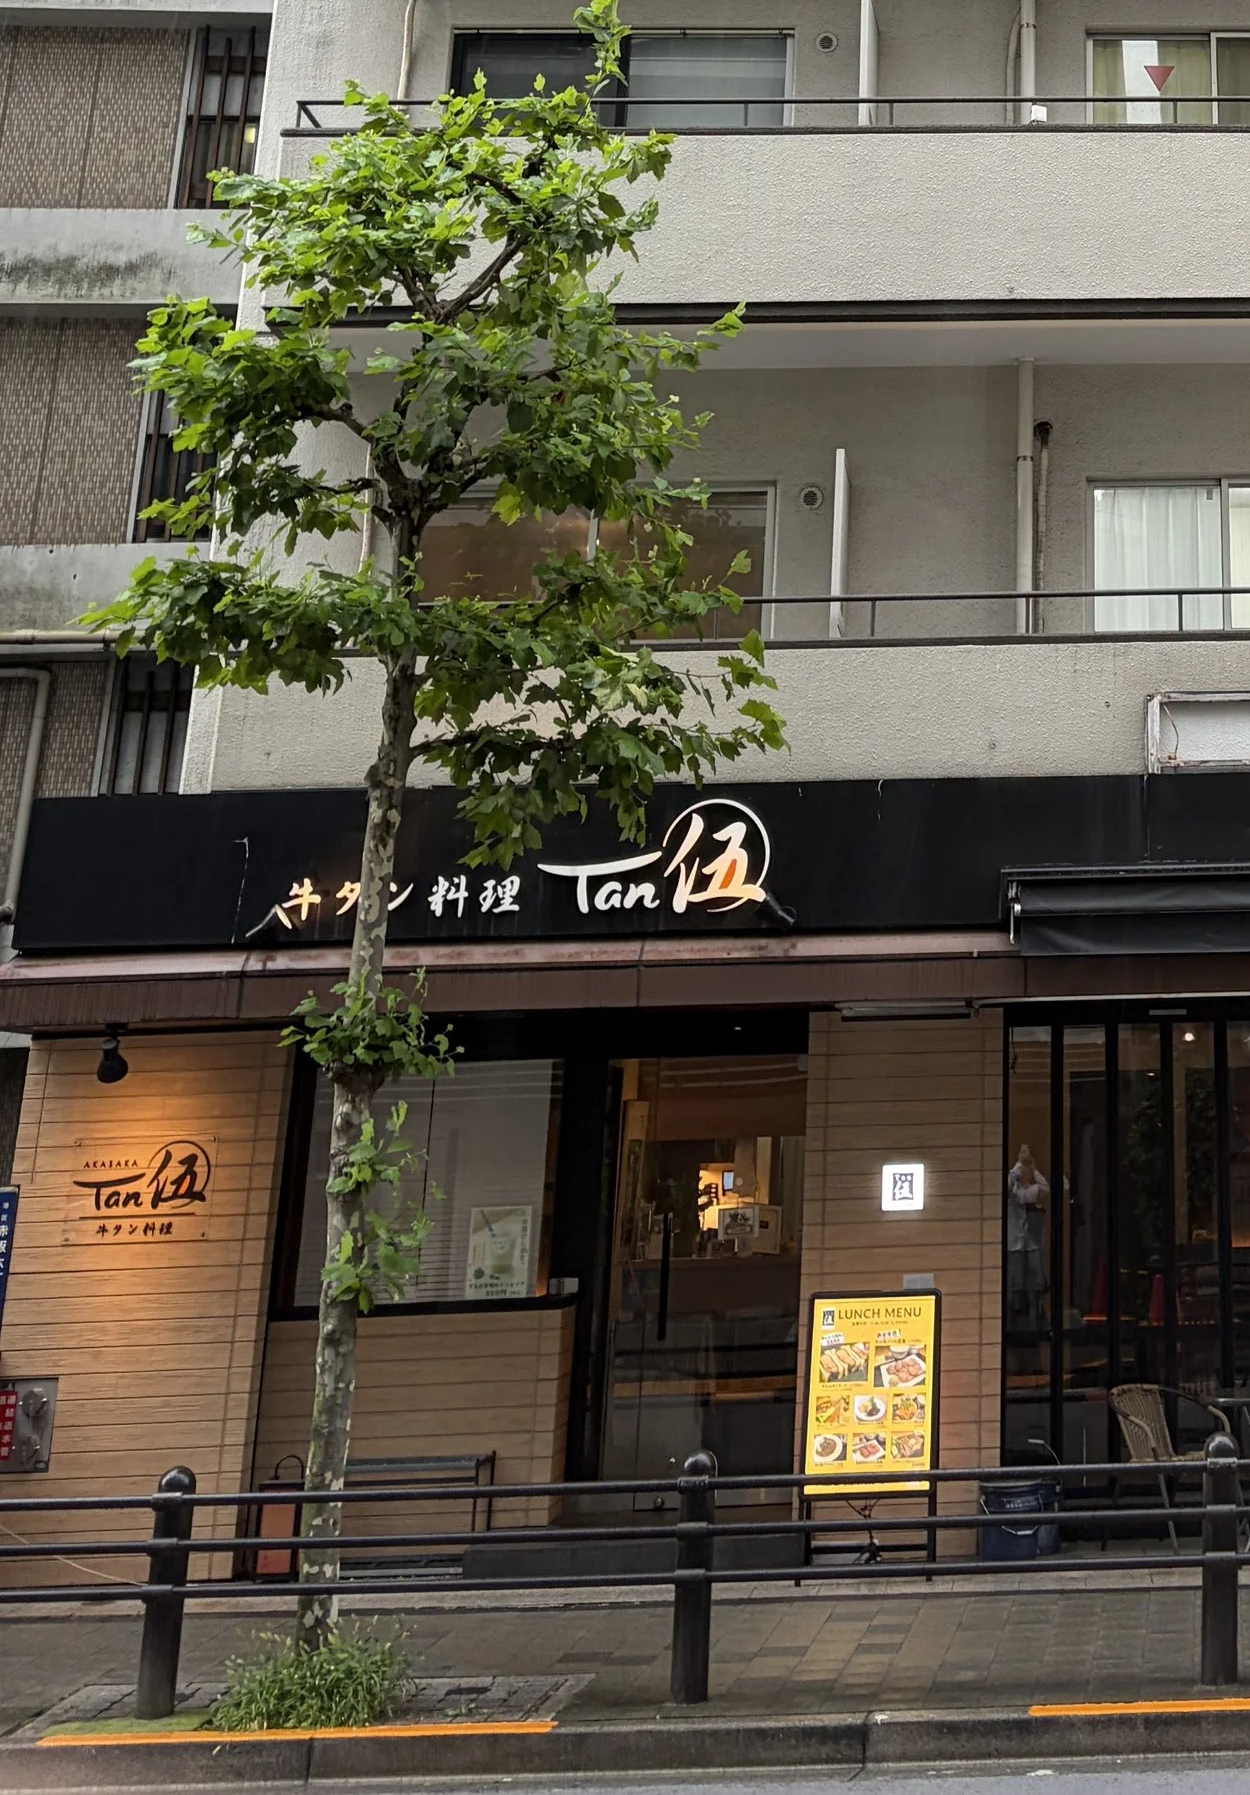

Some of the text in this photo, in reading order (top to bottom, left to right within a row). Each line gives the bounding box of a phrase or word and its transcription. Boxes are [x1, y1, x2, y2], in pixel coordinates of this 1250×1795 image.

[83, 1159, 138, 1169] AKASAKA
[96, 1221, 173, 1237] 牛タン料理
[838, 1308, 880, 1320] LUNCH
[884, 1307, 922, 1318] MENU
